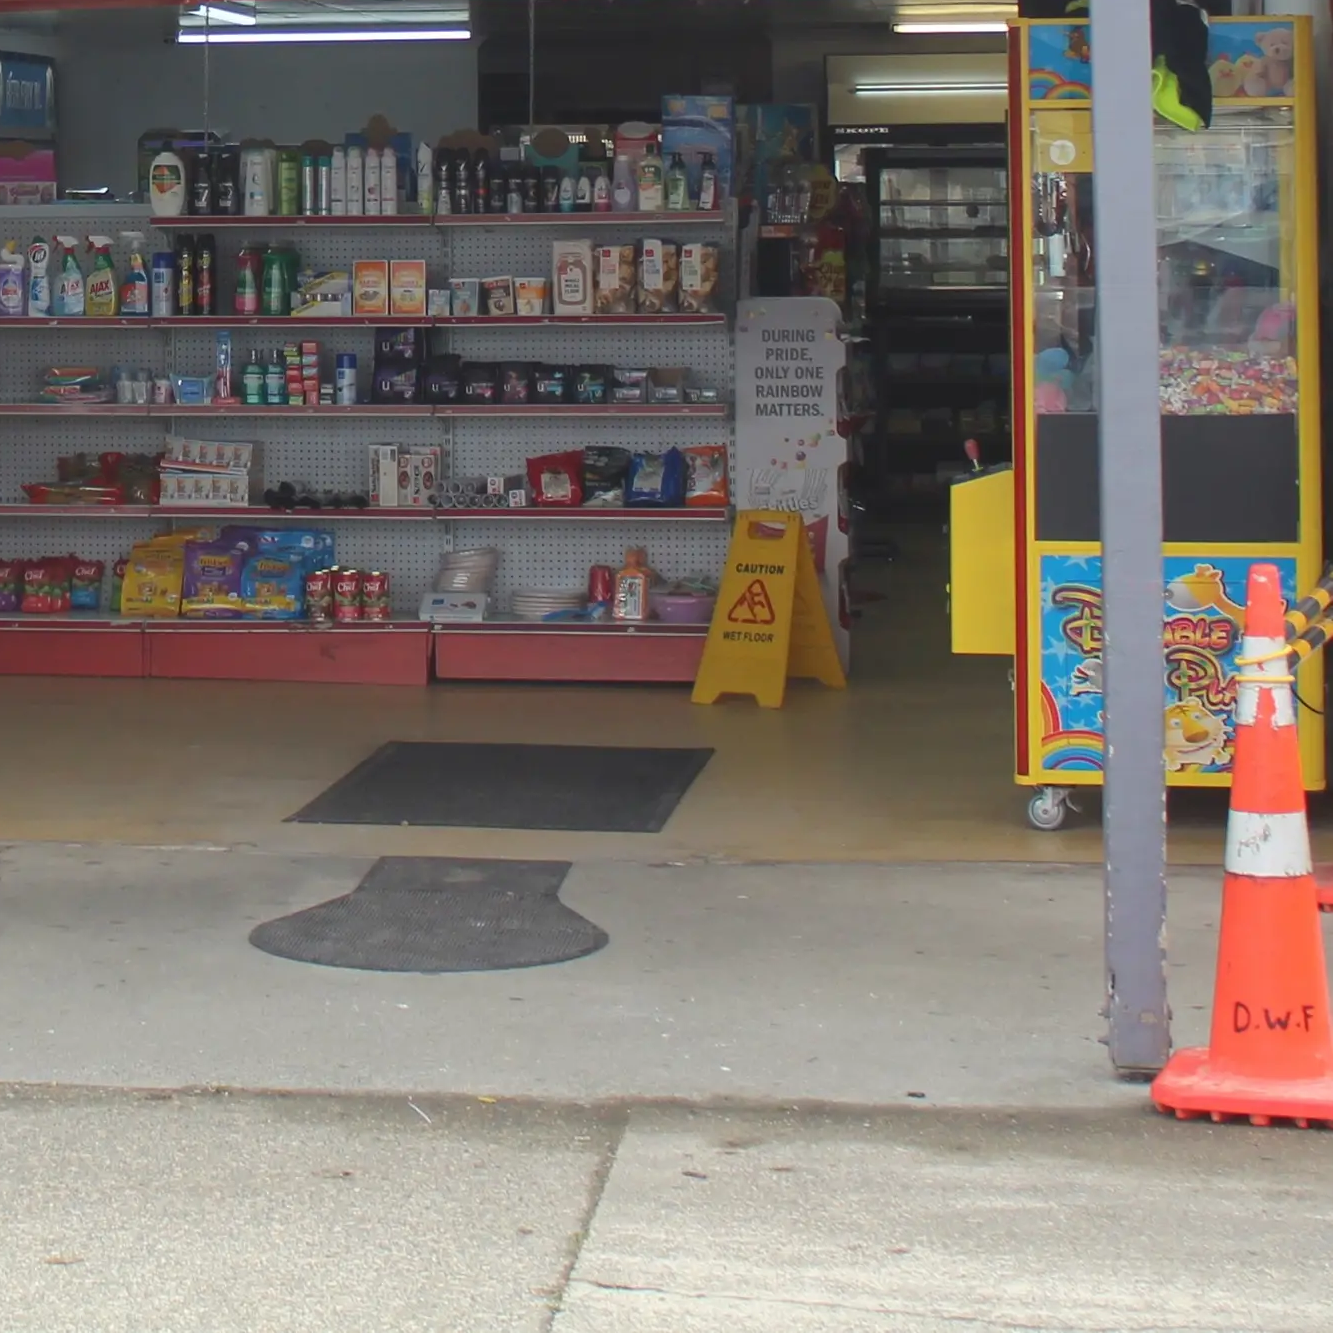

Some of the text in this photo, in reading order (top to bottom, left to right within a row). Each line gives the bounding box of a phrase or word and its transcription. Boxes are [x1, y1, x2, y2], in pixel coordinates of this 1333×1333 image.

[90, 279, 110, 295] AJAX
[762, 329, 815, 342] DURING
[765, 348, 813, 362] PRIDE,
[754, 367, 823, 379] ONLY ONE
[756, 385, 823, 398] RAINBOW
[755, 404, 824, 417] MATTERS.
[736, 563, 785, 574] CAUTION
[723, 631, 774, 643] WET FLOOR
